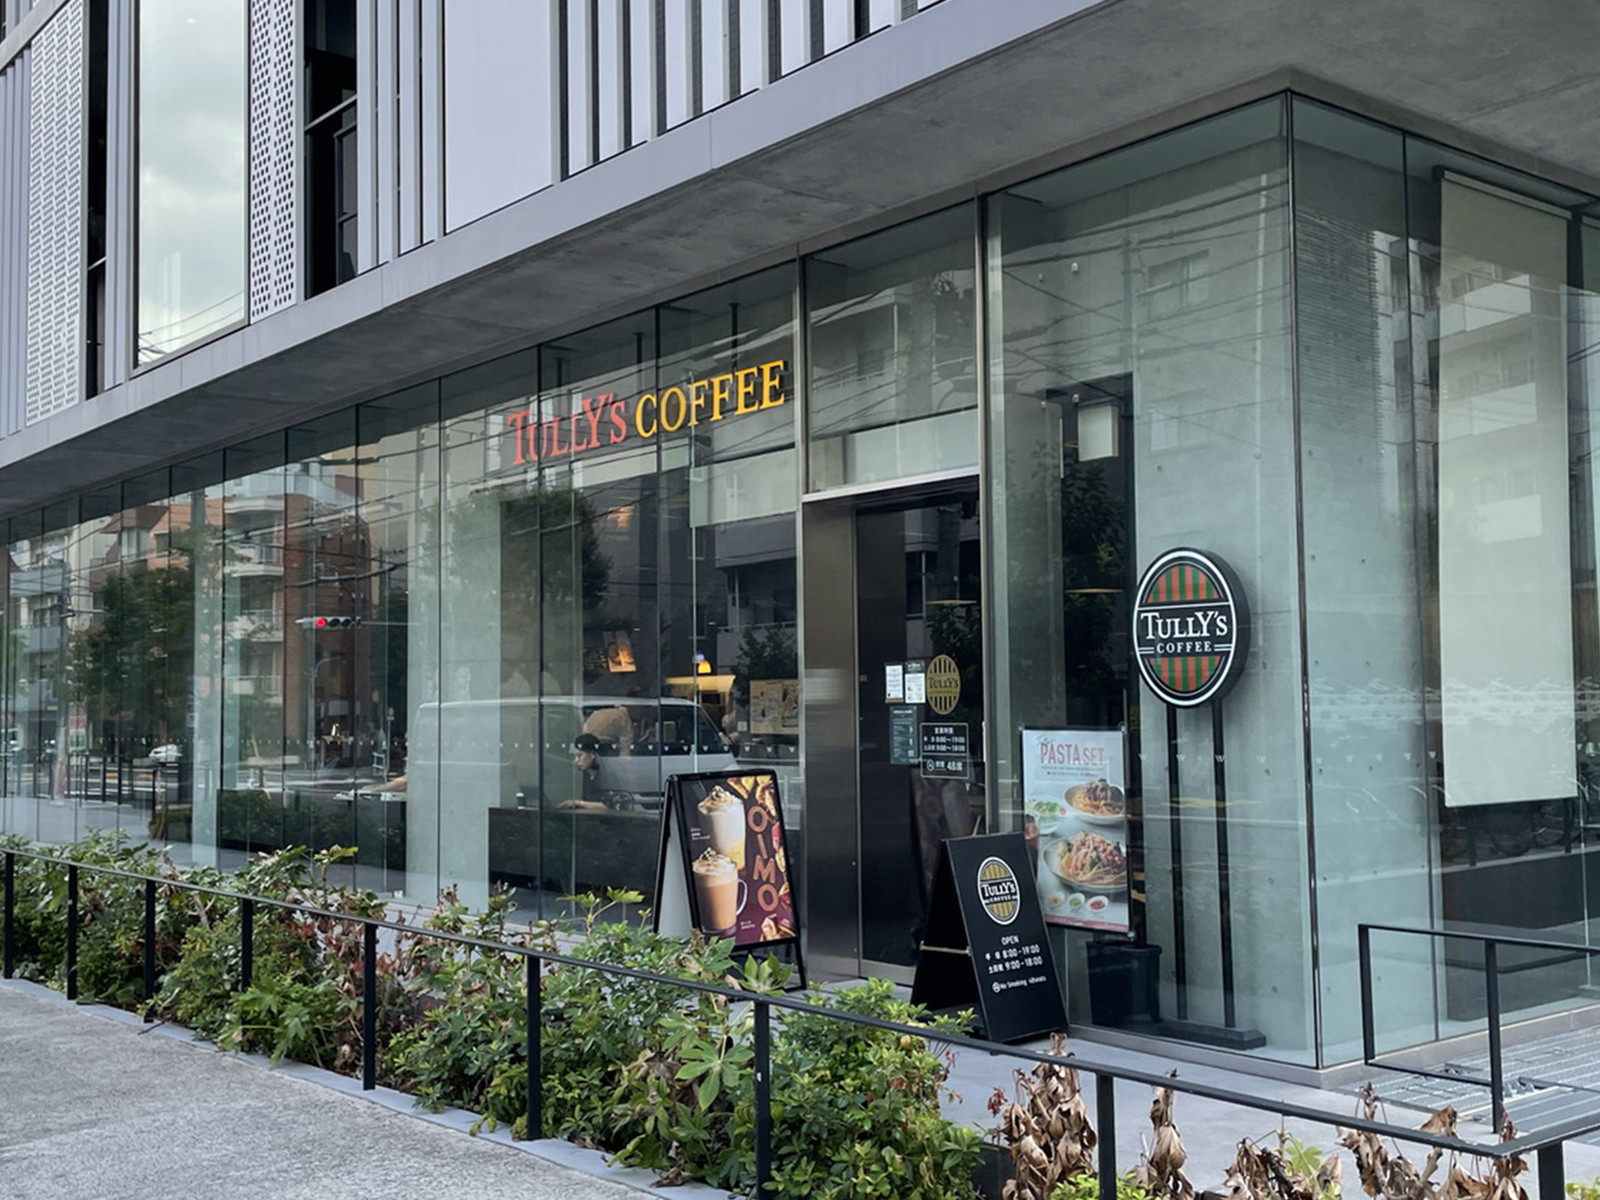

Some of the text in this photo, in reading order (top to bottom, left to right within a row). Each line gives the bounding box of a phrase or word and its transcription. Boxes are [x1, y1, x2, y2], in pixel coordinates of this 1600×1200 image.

[635, 360, 786, 438] COFFEE
[1156, 641, 1212, 654] COFFEE
[1040, 742, 1105, 766] PASTA SET
[1001, 935, 1019, 945] OPEN
